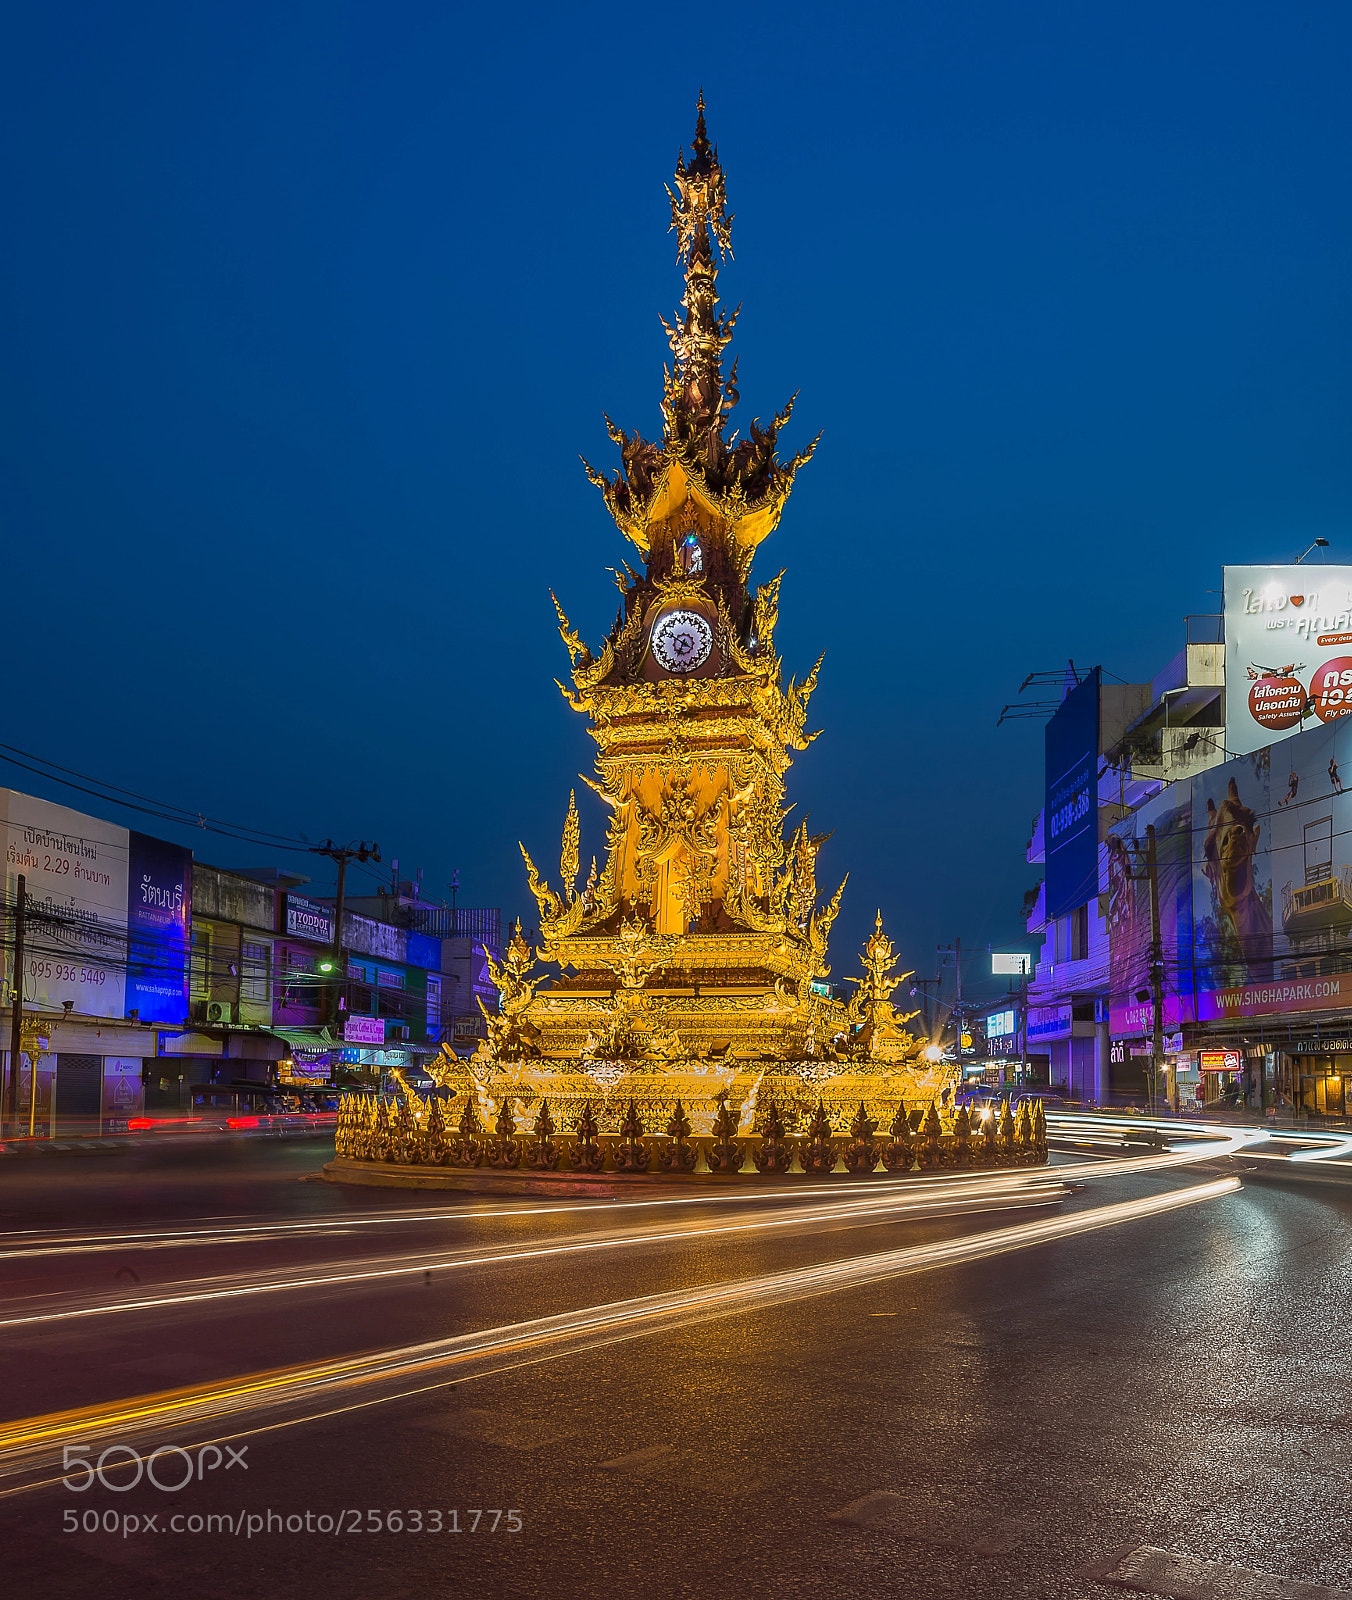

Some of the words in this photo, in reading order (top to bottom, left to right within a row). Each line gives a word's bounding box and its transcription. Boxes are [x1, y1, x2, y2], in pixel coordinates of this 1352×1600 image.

[1320, 636, 1338, 644] Every
[1253, 684, 1302, 699] ใส่ใจความ
[1255, 697, 1301, 712] ปลอดภัย
[1324, 709, 1339, 718] Fly
[1257, 712, 1278, 721] Safety
[23, 825, 98, 861] เปิดบ้านโซนใหม่
[6, 841, 39, 869] เริ่มต้น
[43, 855, 70, 875] 2.29
[73, 861, 111, 886] ล้านบาท
[140, 874, 183, 920] รัตนบุรี
[30, 960, 52, 979] 095
[55, 964, 76, 982] 936
[80, 967, 106, 986] 5449
[1215, 980, 1341, 1009] WWW.SINGHAPARK.COM
